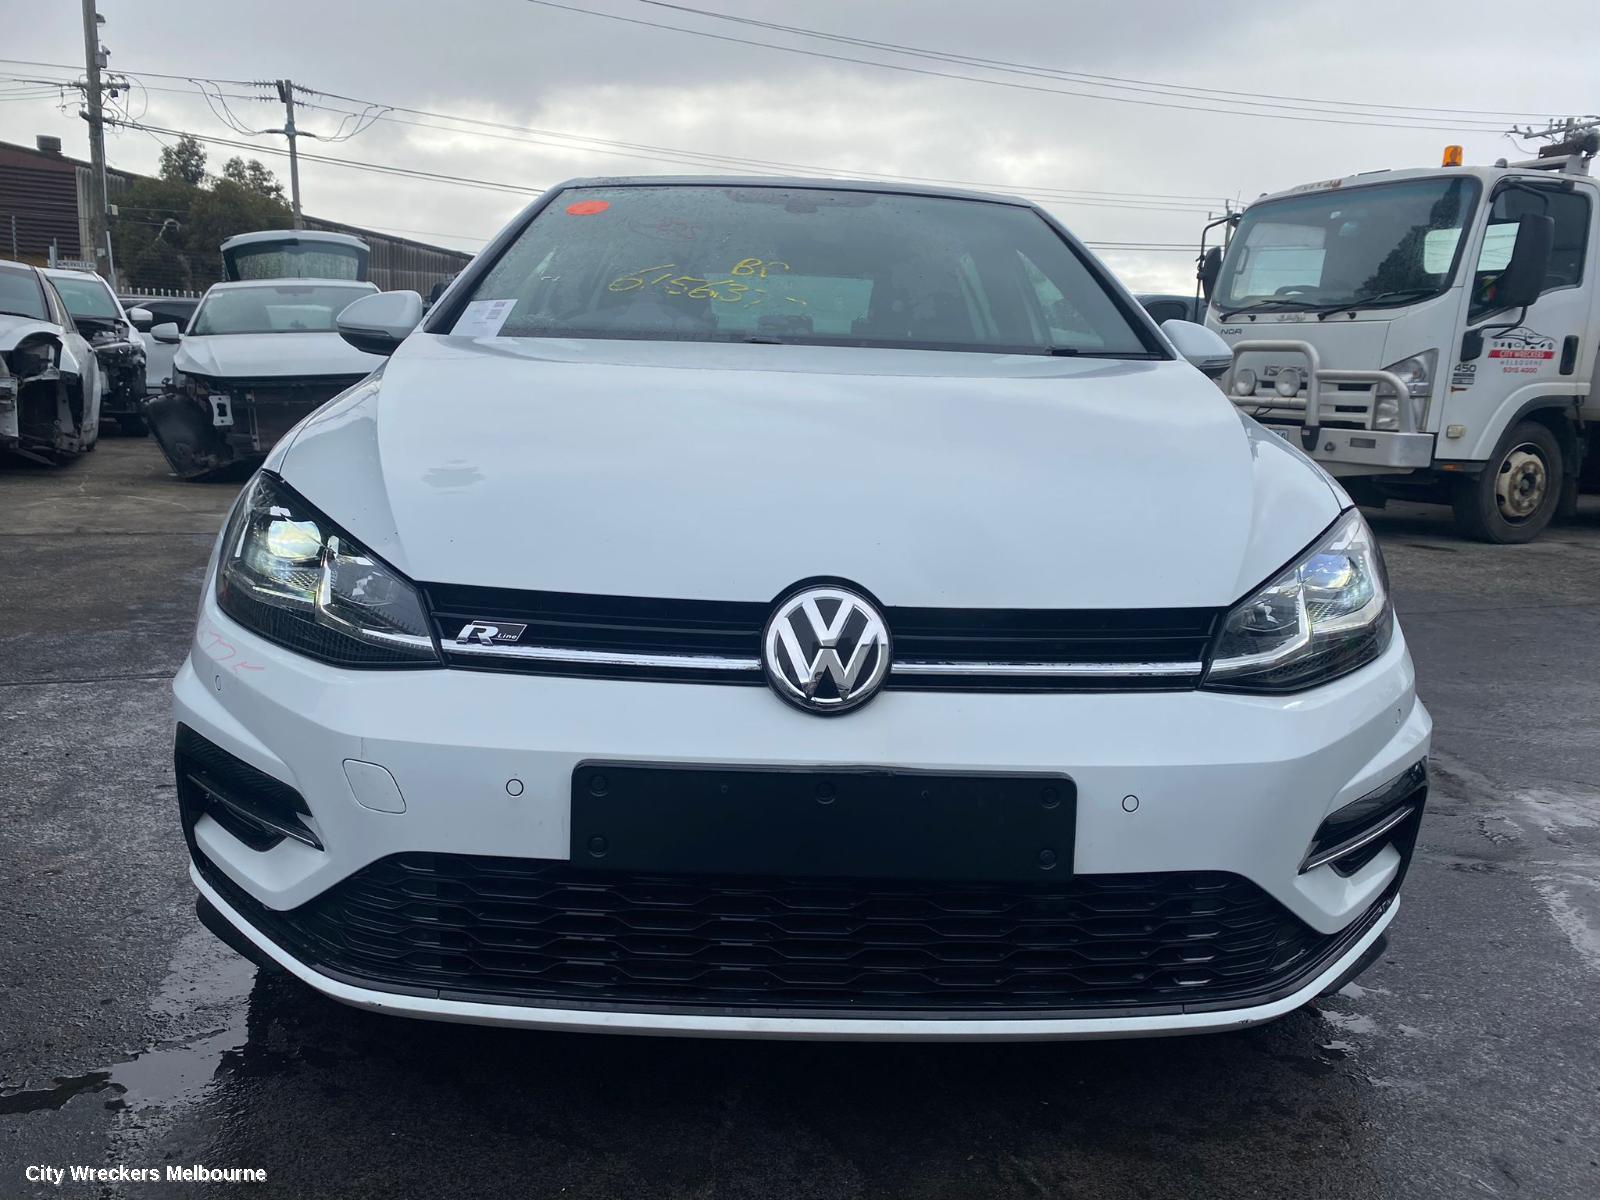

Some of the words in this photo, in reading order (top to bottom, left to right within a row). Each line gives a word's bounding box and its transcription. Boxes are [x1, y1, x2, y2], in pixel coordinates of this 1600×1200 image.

[1454, 363, 1477, 373] 450
[456, 624, 499, 647] R
[497, 633, 518, 641] Line
